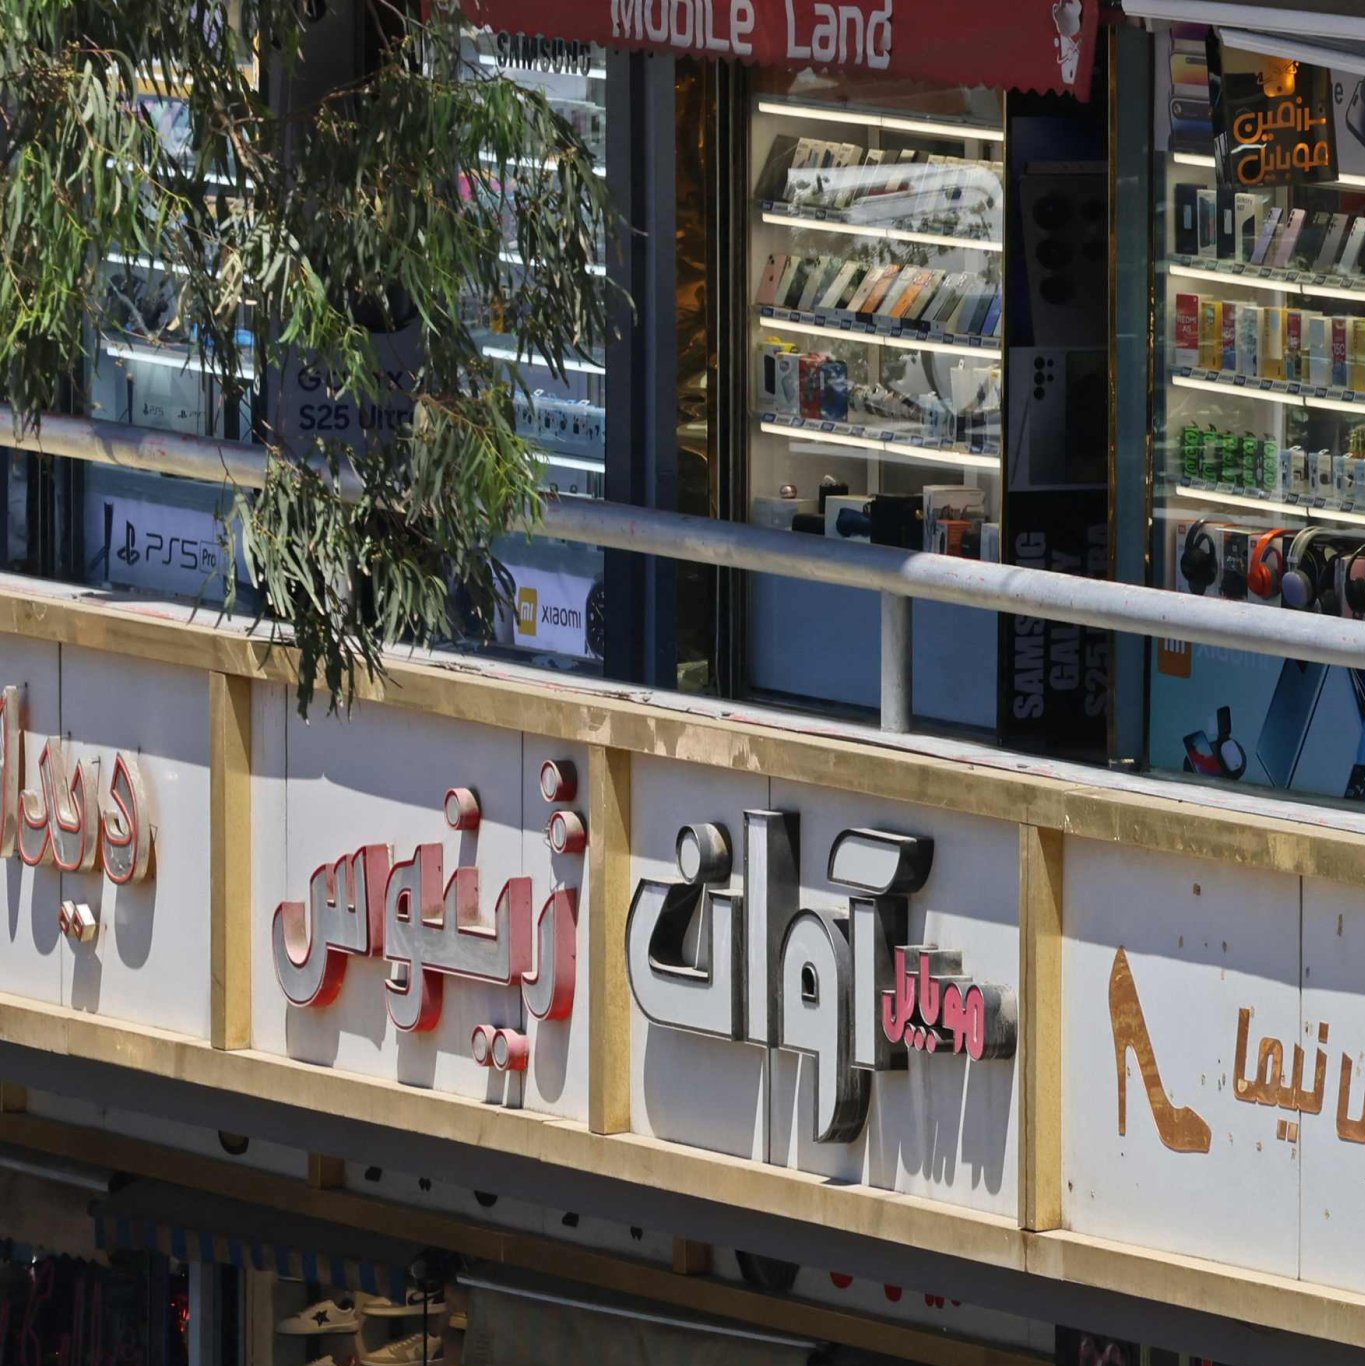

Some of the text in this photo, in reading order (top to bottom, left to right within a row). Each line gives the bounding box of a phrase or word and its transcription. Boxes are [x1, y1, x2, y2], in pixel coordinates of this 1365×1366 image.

[497, 32, 590, 76] SAMSUNG
[1236, 142, 1329, 185] موبایل
[300, 404, 350, 431] S25
[146, 532, 217, 570] PS5 Pro
[540, 605, 582, 631] xiaomi
[1013, 531, 1047, 718] SAMSG
[1049, 549, 1081, 690] GALY
[626, 809, 934, 1144] آوان
[882, 945, 1017, 1061] موبایل
[1233, 1007, 1329, 1142] نیما
